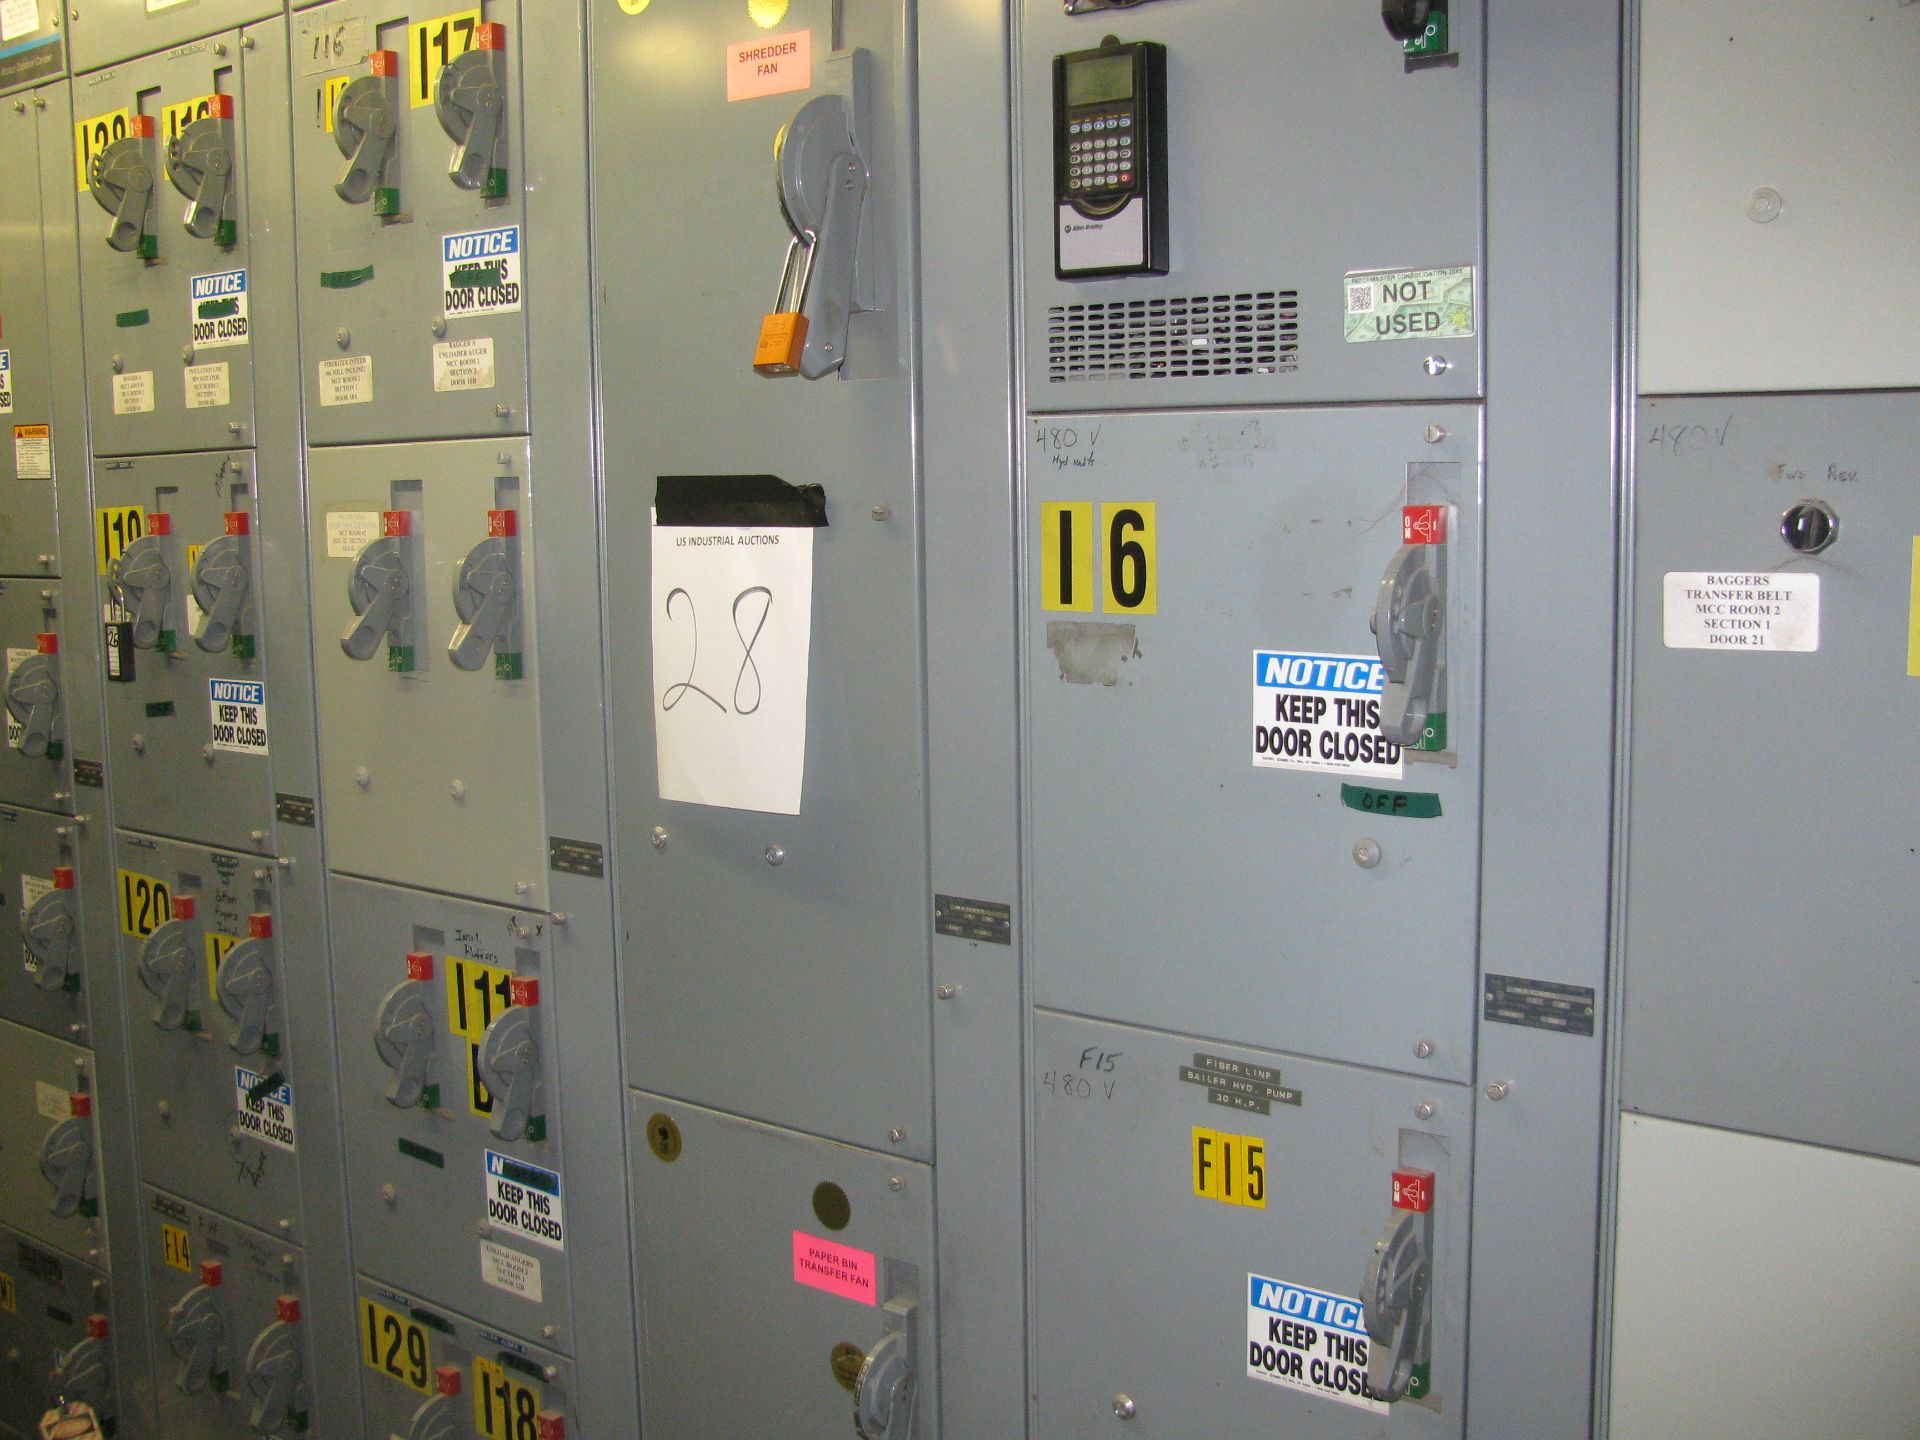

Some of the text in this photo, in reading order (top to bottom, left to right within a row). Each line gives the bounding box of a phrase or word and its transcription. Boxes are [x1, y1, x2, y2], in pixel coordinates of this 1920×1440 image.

[739, 42, 797, 63] SHREDDER
[757, 63, 778, 76] FAN
[449, 230, 513, 259] NOTICE
[196, 273, 242, 296] NOTICE
[1351, 274, 1395, 285] PATCHMASTER
[1397, 270, 1447, 281] CONSOLIDATION
[445, 282, 520, 311] DOOR CLOSED
[1382, 280, 1432, 303] NOT
[194, 316, 248, 341] DOOR CLOSED
[1376, 311, 1440, 335] USED
[1036, 427, 1077, 451] 480
[676, 534, 780, 547] US INDUSTRIAL AUCTIONS
[1707, 575, 1770, 586] BAGGERS
[1685, 589, 1792, 601] TRANSFER BELT
[1696, 604, 1781, 616] MCC ROOM 2
[1704, 619, 1770, 630] SECTION 1
[663, 586, 773, 716] 28
[1709, 634, 1764, 646] DOOR 21
[1264, 657, 1384, 691] NOTICE
[214, 683, 260, 702] NOTICE
[219, 704, 257, 725] KEEP THIS
[1275, 693, 1381, 730] KEEP THIS
[213, 724, 266, 746] DOOR CLOSED
[1255, 725, 1401, 765] DOOR CLOSED
[1362, 793, 1408, 813] OFF
[1079, 1046, 1123, 1073] F15
[1206, 1058, 1271, 1080] FIBER LINE
[1043, 1071, 1115, 1100] 480 V
[1187, 1071, 1293, 1100] BAILER HYD. PUMP
[267, 1102, 285, 1123] THIS
[1216, 1093, 1260, 1110] 30 H.P.
[240, 1110, 294, 1145] DOOR CLOSED
[497, 1180, 551, 1216] KEEP THIS
[489, 1198, 518, 1226] DOOR
[521, 1210, 562, 1241] CLOSED
[809, 1248, 858, 1271] PAPER BIN
[800, 1258, 869, 1288] TRANSFER FAN
[1259, 1282, 1368, 1330] NOTIC
[1268, 1316, 1368, 1367] KEEP THIS
[1250, 1341, 1303, 1380] DOOR
[1310, 1358, 1375, 1400] CLOSE
